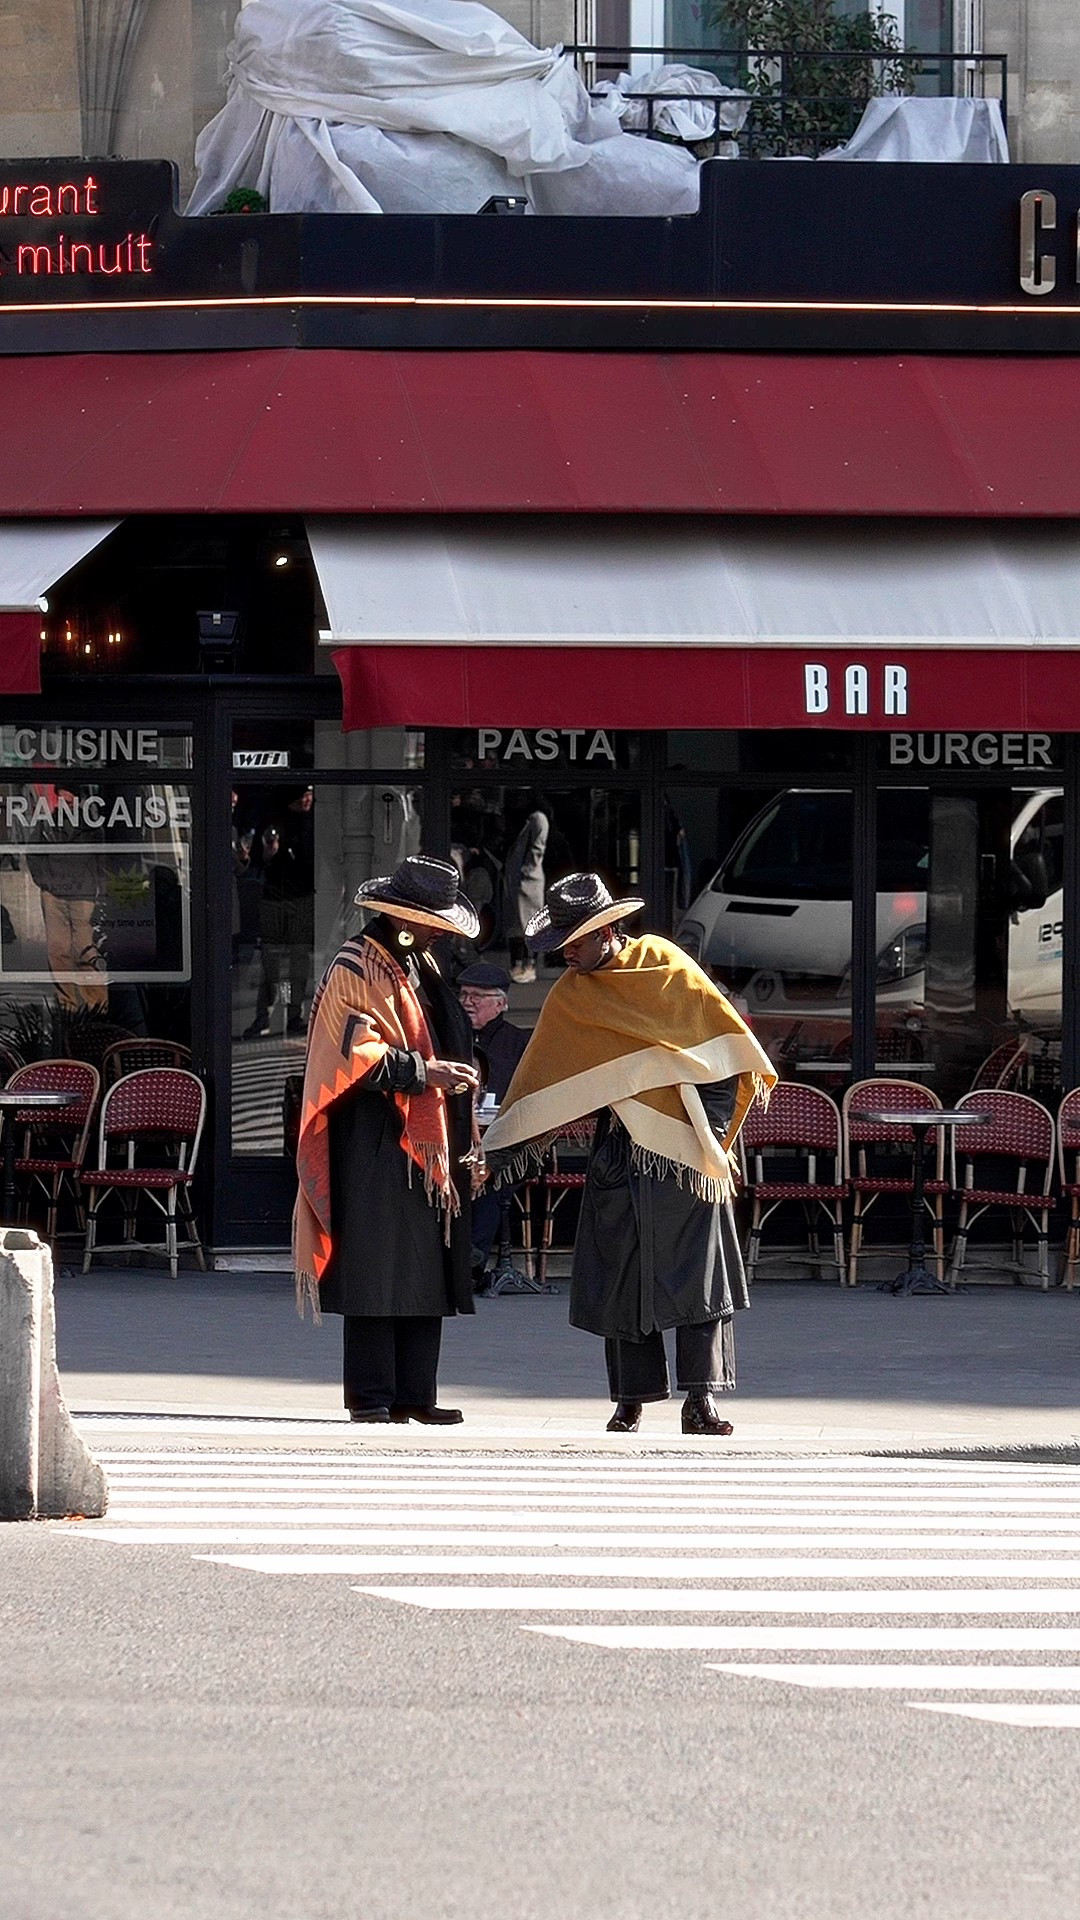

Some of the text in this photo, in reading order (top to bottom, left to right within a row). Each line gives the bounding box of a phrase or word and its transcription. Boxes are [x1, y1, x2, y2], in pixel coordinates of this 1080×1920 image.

[17, 233, 152, 275] minuit
[1019, 188, 1080, 295] C
[804, 663, 908, 716] BAR
[13, 728, 159, 762] CUISINE
[477, 728, 616, 761] PASTA
[889, 732, 1053, 766] BURGER
[0, 795, 191, 829] RANCAISE
